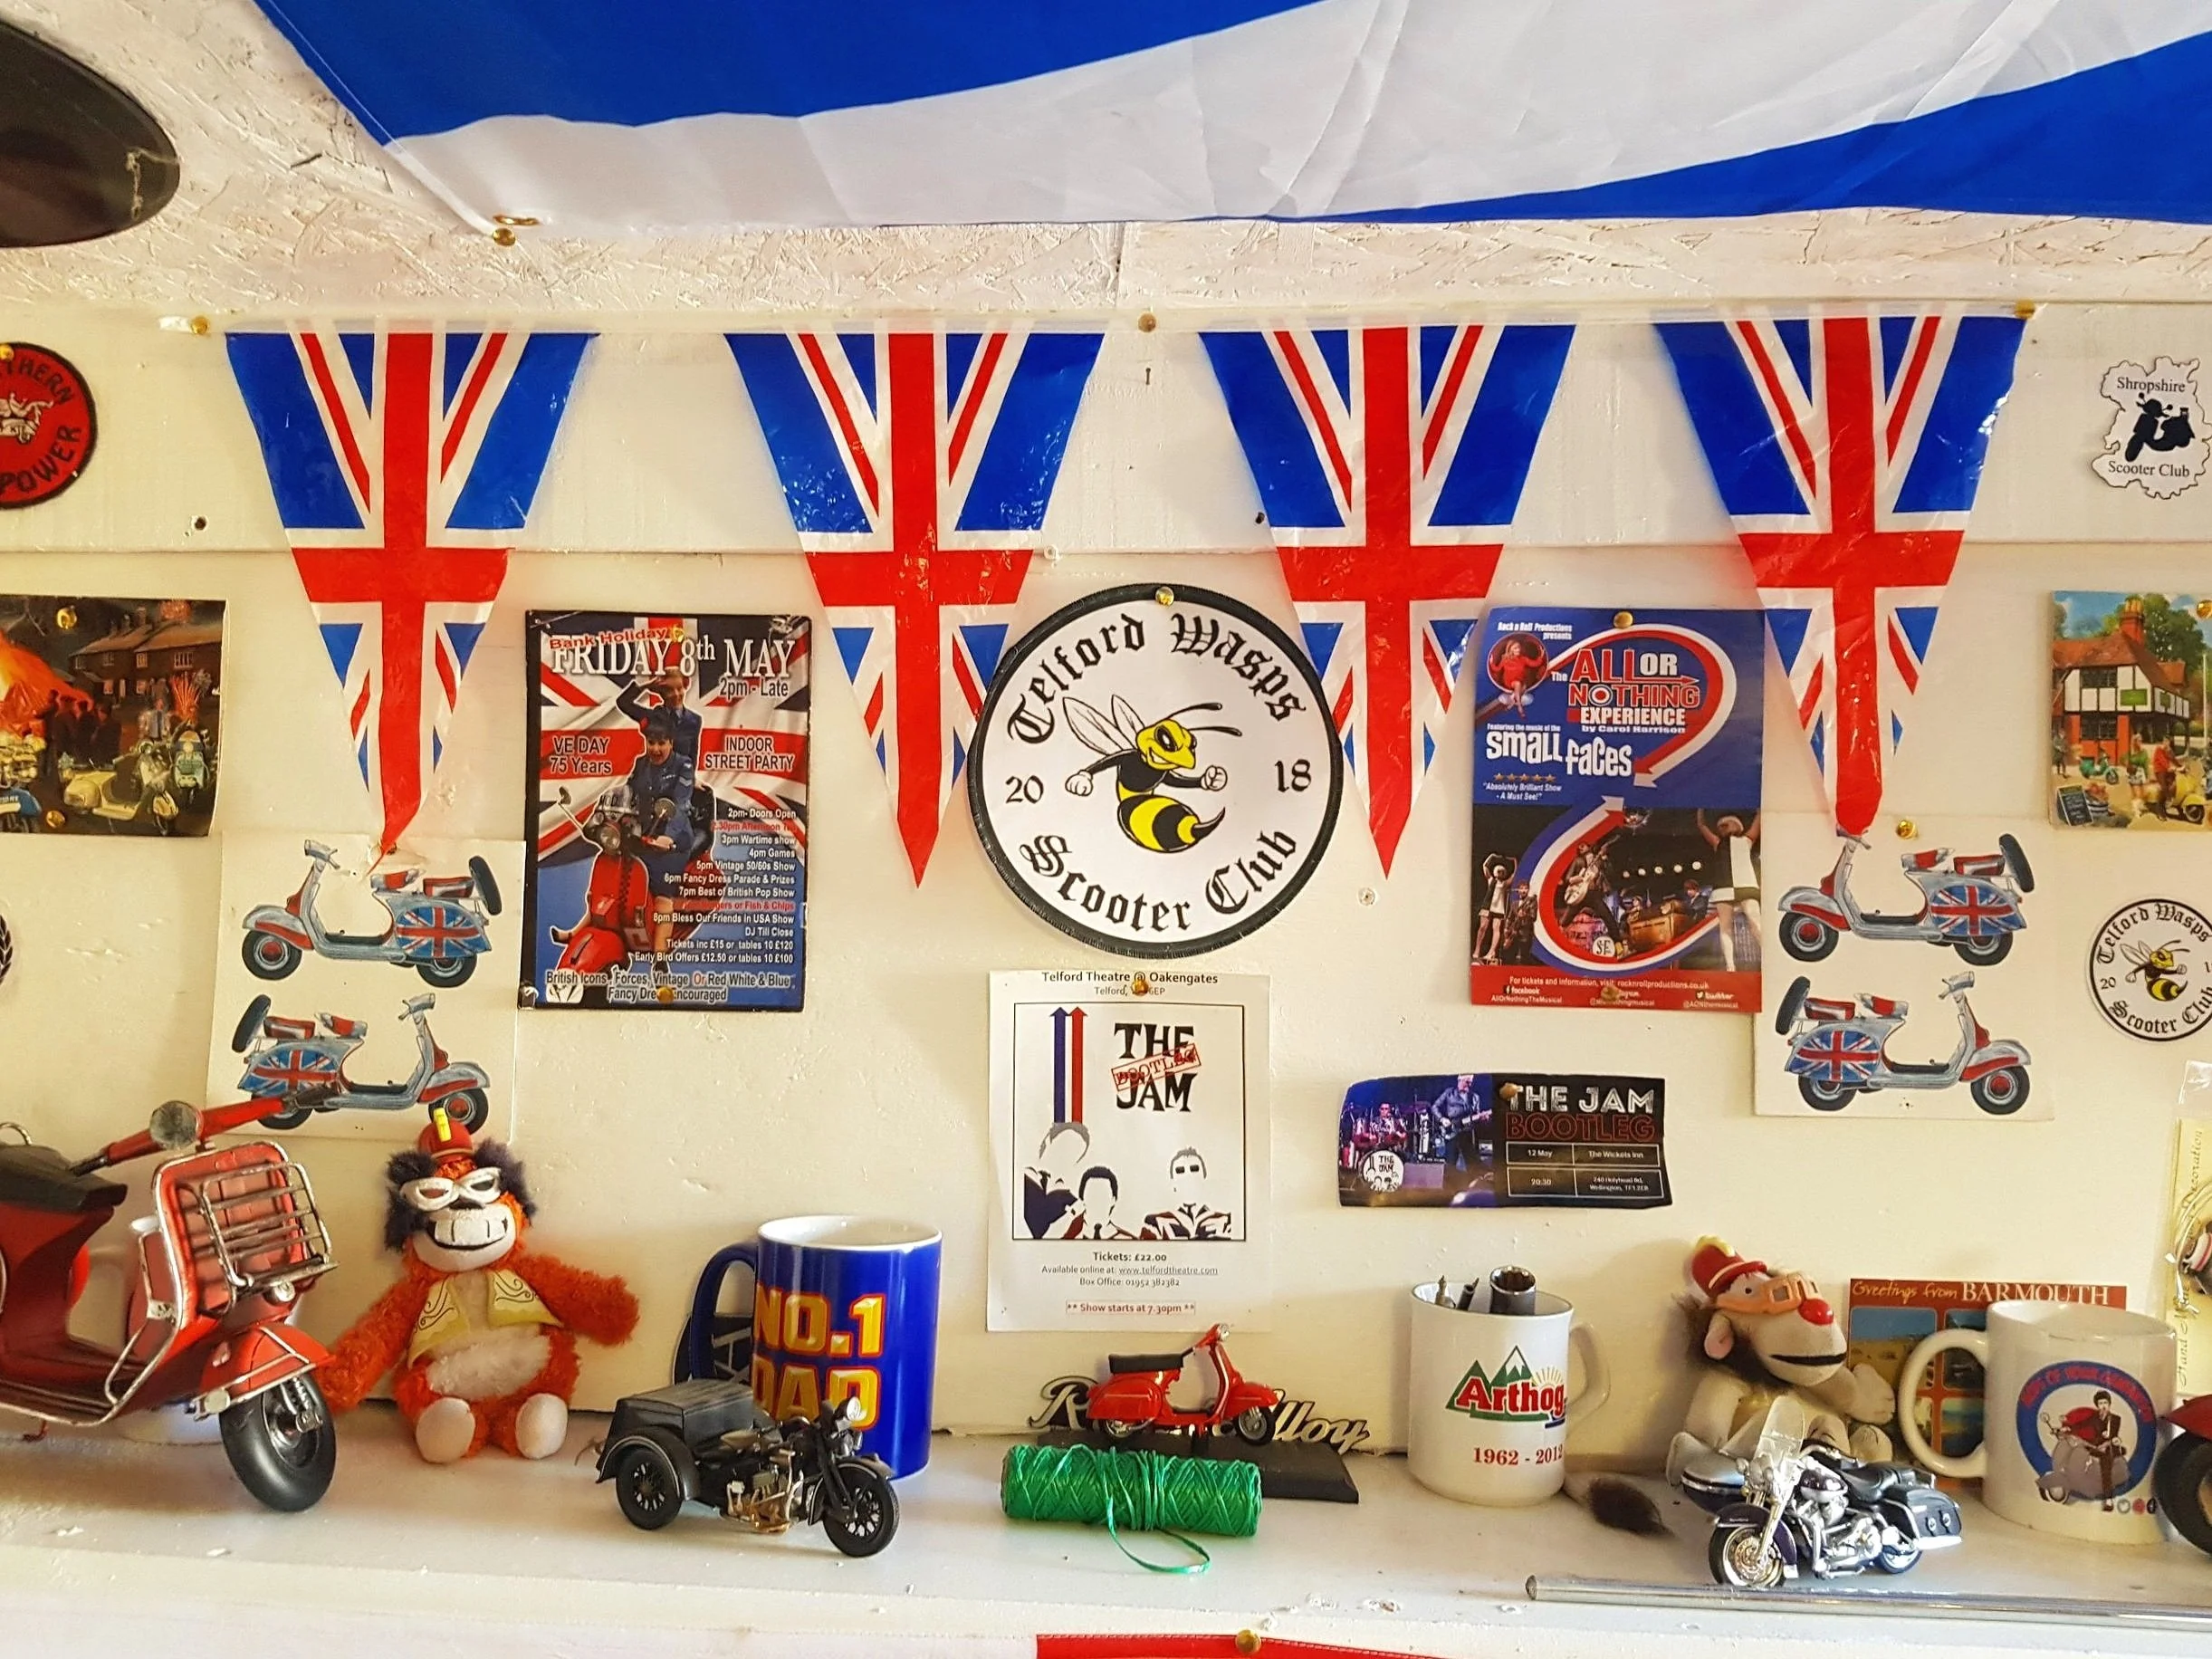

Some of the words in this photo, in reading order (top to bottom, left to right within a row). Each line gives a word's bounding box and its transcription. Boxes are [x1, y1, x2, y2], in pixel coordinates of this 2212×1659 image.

[2, 358, 73, 405] THERN
[2117, 376, 2186, 395] Shropshire
[0, 425, 81, 494] POWER
[2108, 460, 2156, 476] Scooter
[2159, 463, 2190, 477] Club
[1534, 623, 1573, 632] Productions
[550, 635, 594, 649] Bank
[551, 637, 672, 676] FRIDAY
[680, 635, 716, 676] 8th
[723, 638, 796, 678] MAY
[1551, 671, 1567, 681] The
[1569, 648, 1635, 684] ALL
[1640, 653, 1678, 676] OR
[1008, 613, 1146, 744] Telford
[1171, 613, 1307, 722] Wasps
[720, 680, 750, 698] 2pm
[761, 680, 789, 696] Late
[1568, 684, 1700, 708] NOTHING
[1580, 707, 1685, 726] EXPERIENCE
[1581, 724, 1596, 734] by
[1598, 724, 1630, 733] Carol
[1633, 725, 1686, 734] Harrison
[554, 737, 577, 753] VE
[578, 738, 609, 753] DAY
[725, 737, 773, 753] INDOOR
[550, 757, 569, 772] 75
[570, 758, 612, 773] Years
[704, 753, 752, 769] STREET
[754, 755, 795, 770] PARTY
[1274, 759, 1312, 793] 18
[1005, 774, 1045, 804] 20
[1544, 784, 1562, 792] Show
[750, 808, 773, 819] Doors
[775, 809, 797, 820] Open
[722, 835, 739, 845] 3pm
[741, 835, 772, 845] Wartime
[774, 836, 796, 845] show
[749, 849, 766, 858] 4pm
[768, 849, 795, 858] Games
[696, 861, 713, 871] 5pm
[715, 861, 744, 872] Vintage
[746, 861, 771, 871] 50/60s
[773, 861, 796, 871] Show
[664, 874, 681, 884] 6pm
[684, 873, 706, 885] Fancy
[709, 875, 732, 884] Dress
[733, 875, 761, 884] Parade
[762, 875, 769, 884] &
[771, 875, 795, 884] Prizes
[1019, 834, 1192, 933] Scooter
[1205, 830, 1298, 915] Club
[679, 887, 696, 897] 7pm
[698, 887, 716, 897] Best
[717, 887, 725, 897] of
[727, 887, 753, 897] British
[755, 887, 771, 898] Pop
[772, 888, 795, 897] Show
[653, 913, 671, 924] 8pm
[672, 913, 694, 923] Bless
[695, 913, 712, 923] Our
[713, 914, 742, 923] Friends
[753, 914, 771, 924] USA
[772, 915, 795, 924] Show
[745, 926, 755, 936] DJ
[758, 926, 770, 936] Till
[771, 927, 794, 937] Close
[2097, 906, 2150, 964] Telford
[2155, 903, 2212, 942] Wasps
[666, 939, 694, 949] Tickets
[696, 940, 708, 949] inc
[710, 940, 724, 949] £15
[725, 942, 735, 950] or
[738, 940, 762, 950] tables
[764, 940, 773, 950] 10
[775, 940, 794, 950] £120
[635, 952, 655, 963] Early
[656, 952, 674, 961] Bird
[675, 953, 699, 962] Offers
[701, 953, 726, 963] £12.50
[728, 954, 736, 963] or
[738, 953, 762, 963] tables
[764, 954, 773, 963] 10
[775, 954, 794, 964] £100
[546, 971, 579, 984] British
[654, 972, 688, 987] Vintage
[694, 973, 705, 985] Or
[708, 973, 726, 985] Red
[729, 973, 755, 986] White
[758, 973, 765, 986] &
[768, 973, 790, 986] Blue
[1042, 972, 1083, 983] Telford
[1086, 972, 1131, 983] Theatre
[1134, 971, 1146, 984] @
[1149, 972, 1219, 986] Oakengates
[2100, 977, 2117, 989] 20
[608, 987, 637, 1002] Fancy
[674, 989, 727, 1003] ncouraged
[1094, 985, 1128, 997] Telford,
[2108, 1000, 2177, 1033] Scooter
[1114, 1022, 1194, 1060] THE
[1116, 1071, 1198, 1113] JAM
[1578, 1087, 1654, 1114] JAM
[1506, 1112, 1655, 1144] BOOTLEG
[1093, 1251, 1132, 1261] Tickets:
[1135, 1252, 1167, 1262] £22.00
[1041, 1265, 1077, 1274] Available
[1079, 1265, 1105, 1274] online
[1118, 1266, 1219, 1276] www.telfordtheatre.com
[1079, 1278, 1096, 1286] Box
[1125, 1279, 1150, 1289] 01952
[1152, 1278, 1180, 1289] 382382
[1852, 1282, 1919, 1305] Greetings
[1922, 1283, 1958, 1299] from
[1961, 1282, 2110, 1306] BARMOUTH
[1080, 1304, 1106, 1313] Show
[1107, 1303, 1134, 1313] starts
[1135, 1304, 1146, 1313] at
[1147, 1304, 1183, 1315] 7.30pm
[753, 1280, 887, 1358] NO.1
[1455, 1376, 1566, 1418] Arthog
[1473, 1447, 1519, 1466] 1962
